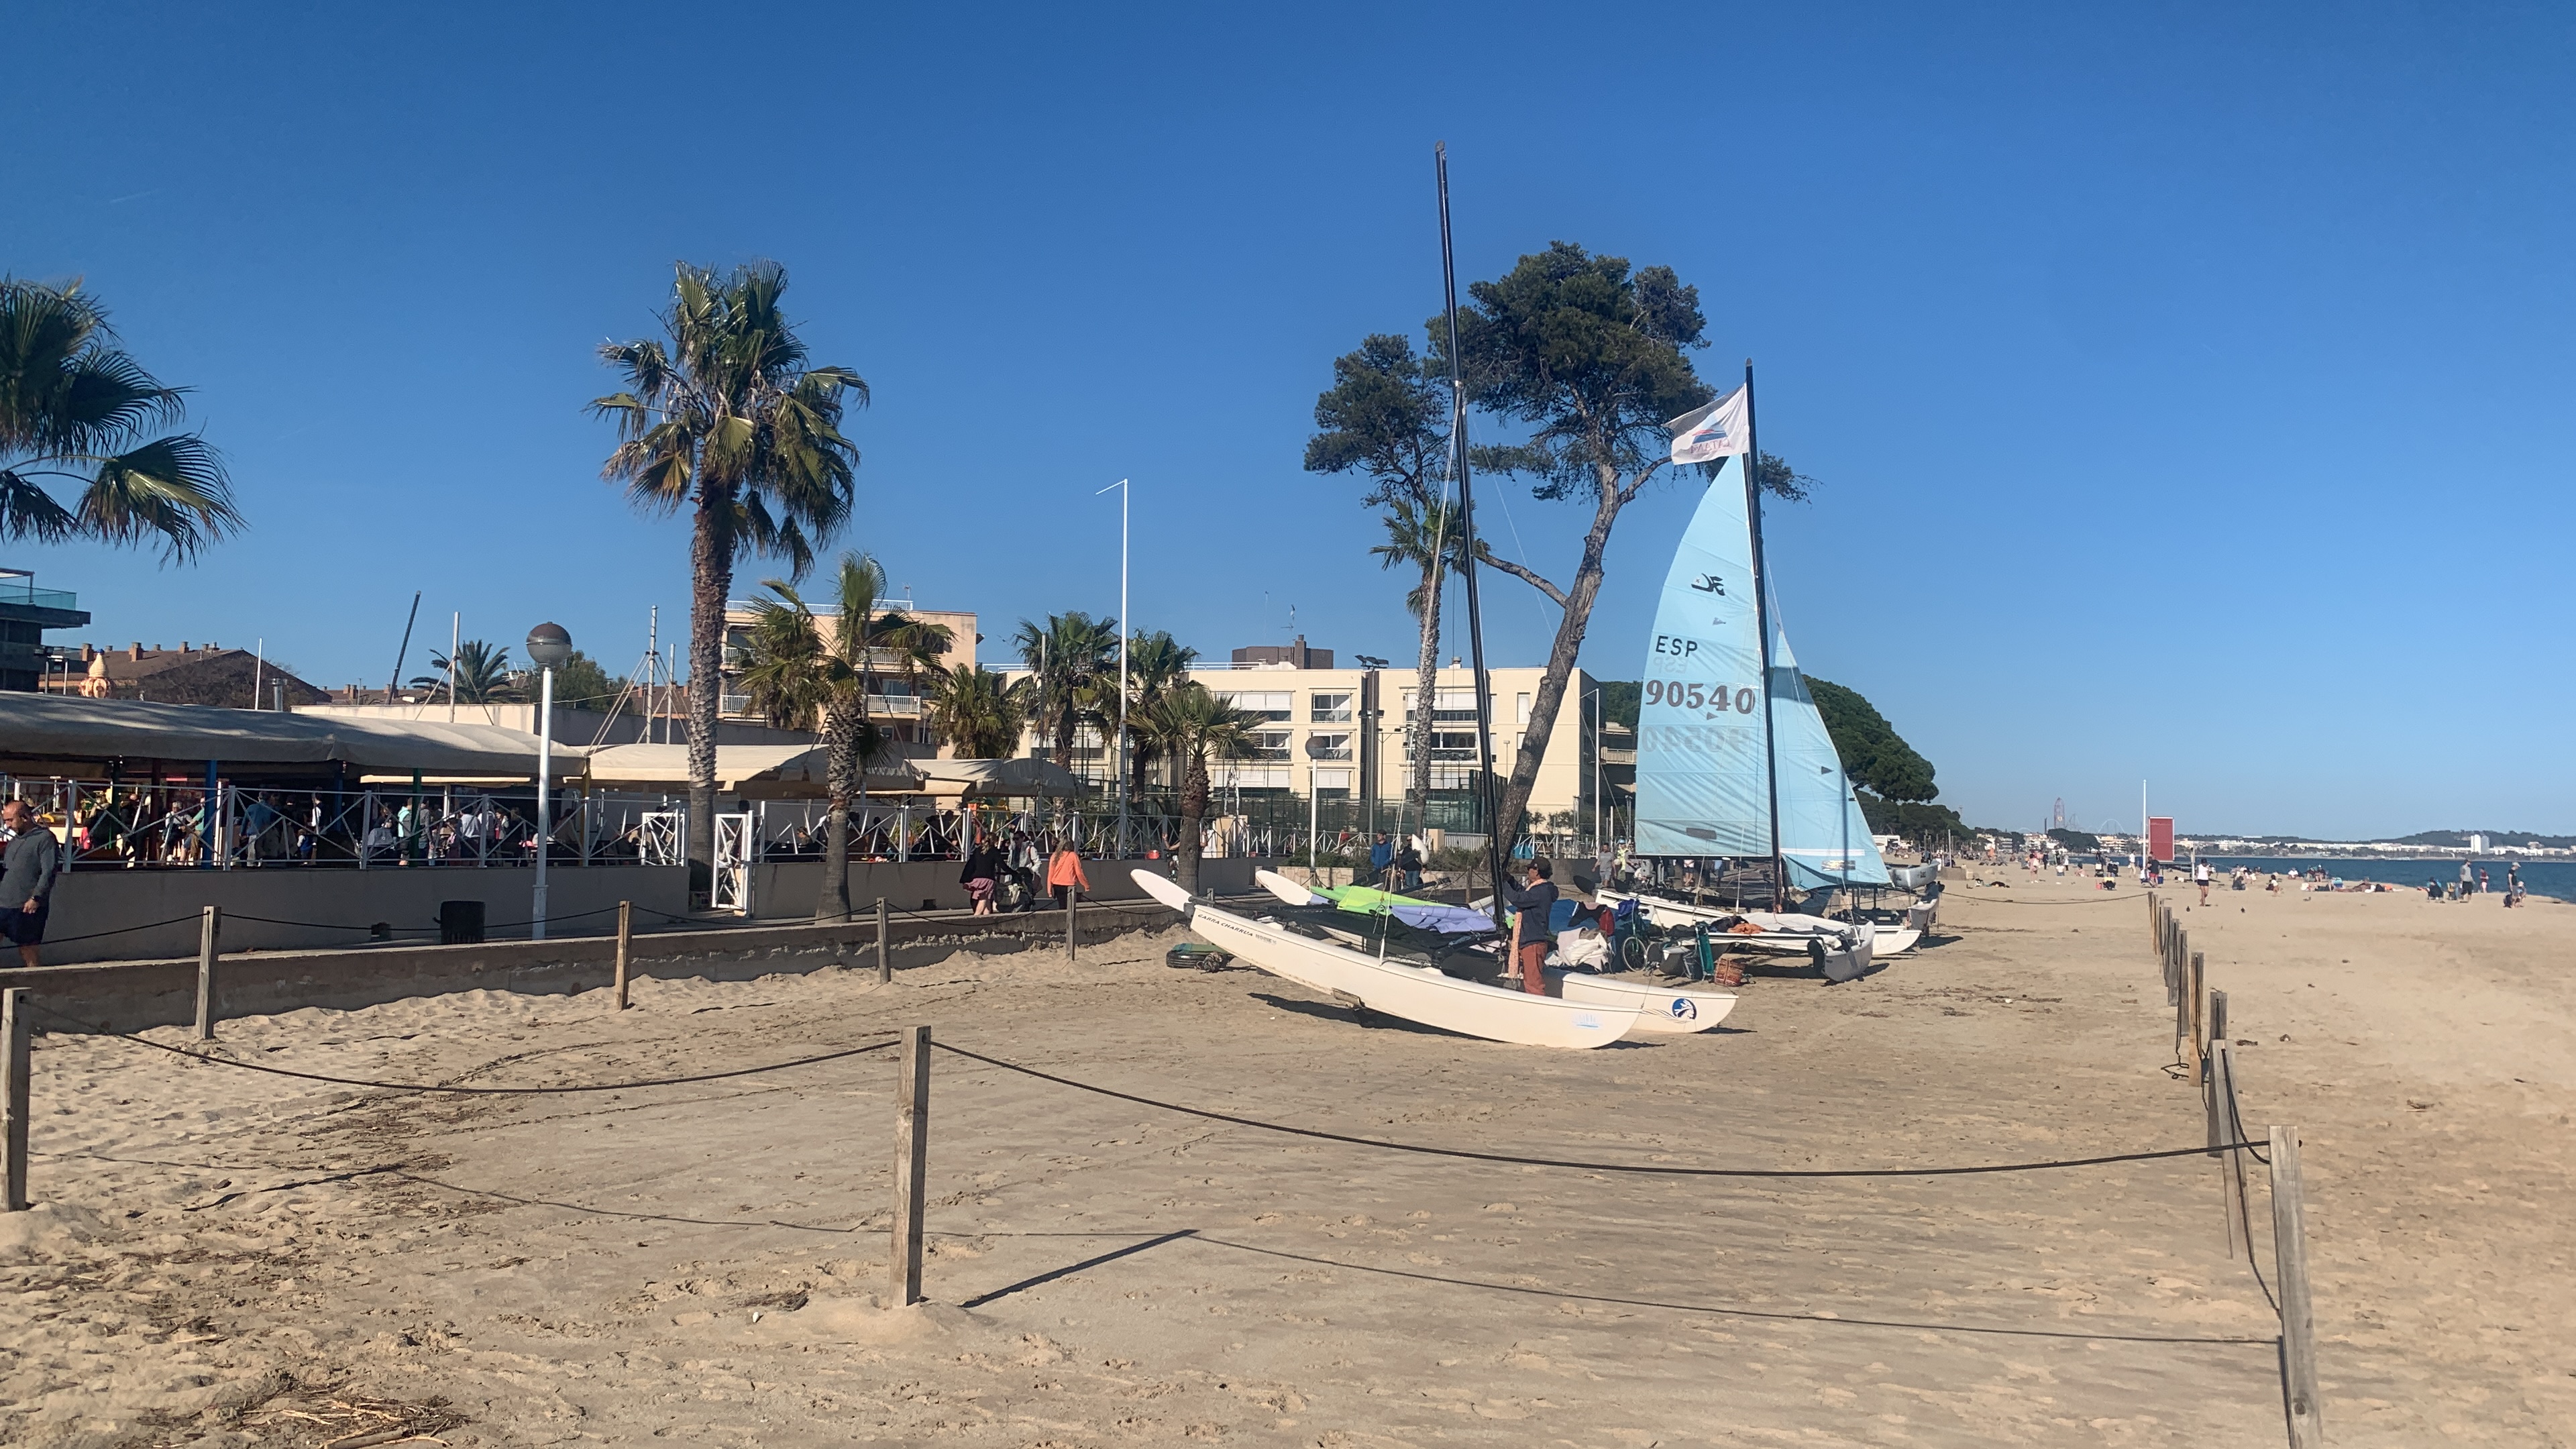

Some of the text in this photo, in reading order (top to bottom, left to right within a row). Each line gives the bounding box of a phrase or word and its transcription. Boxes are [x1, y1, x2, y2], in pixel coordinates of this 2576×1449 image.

[1656, 635, 1698, 657] ESP
[1646, 680, 1756, 714] 90540
[1221, 923, 1253, 936] CHARRUA
